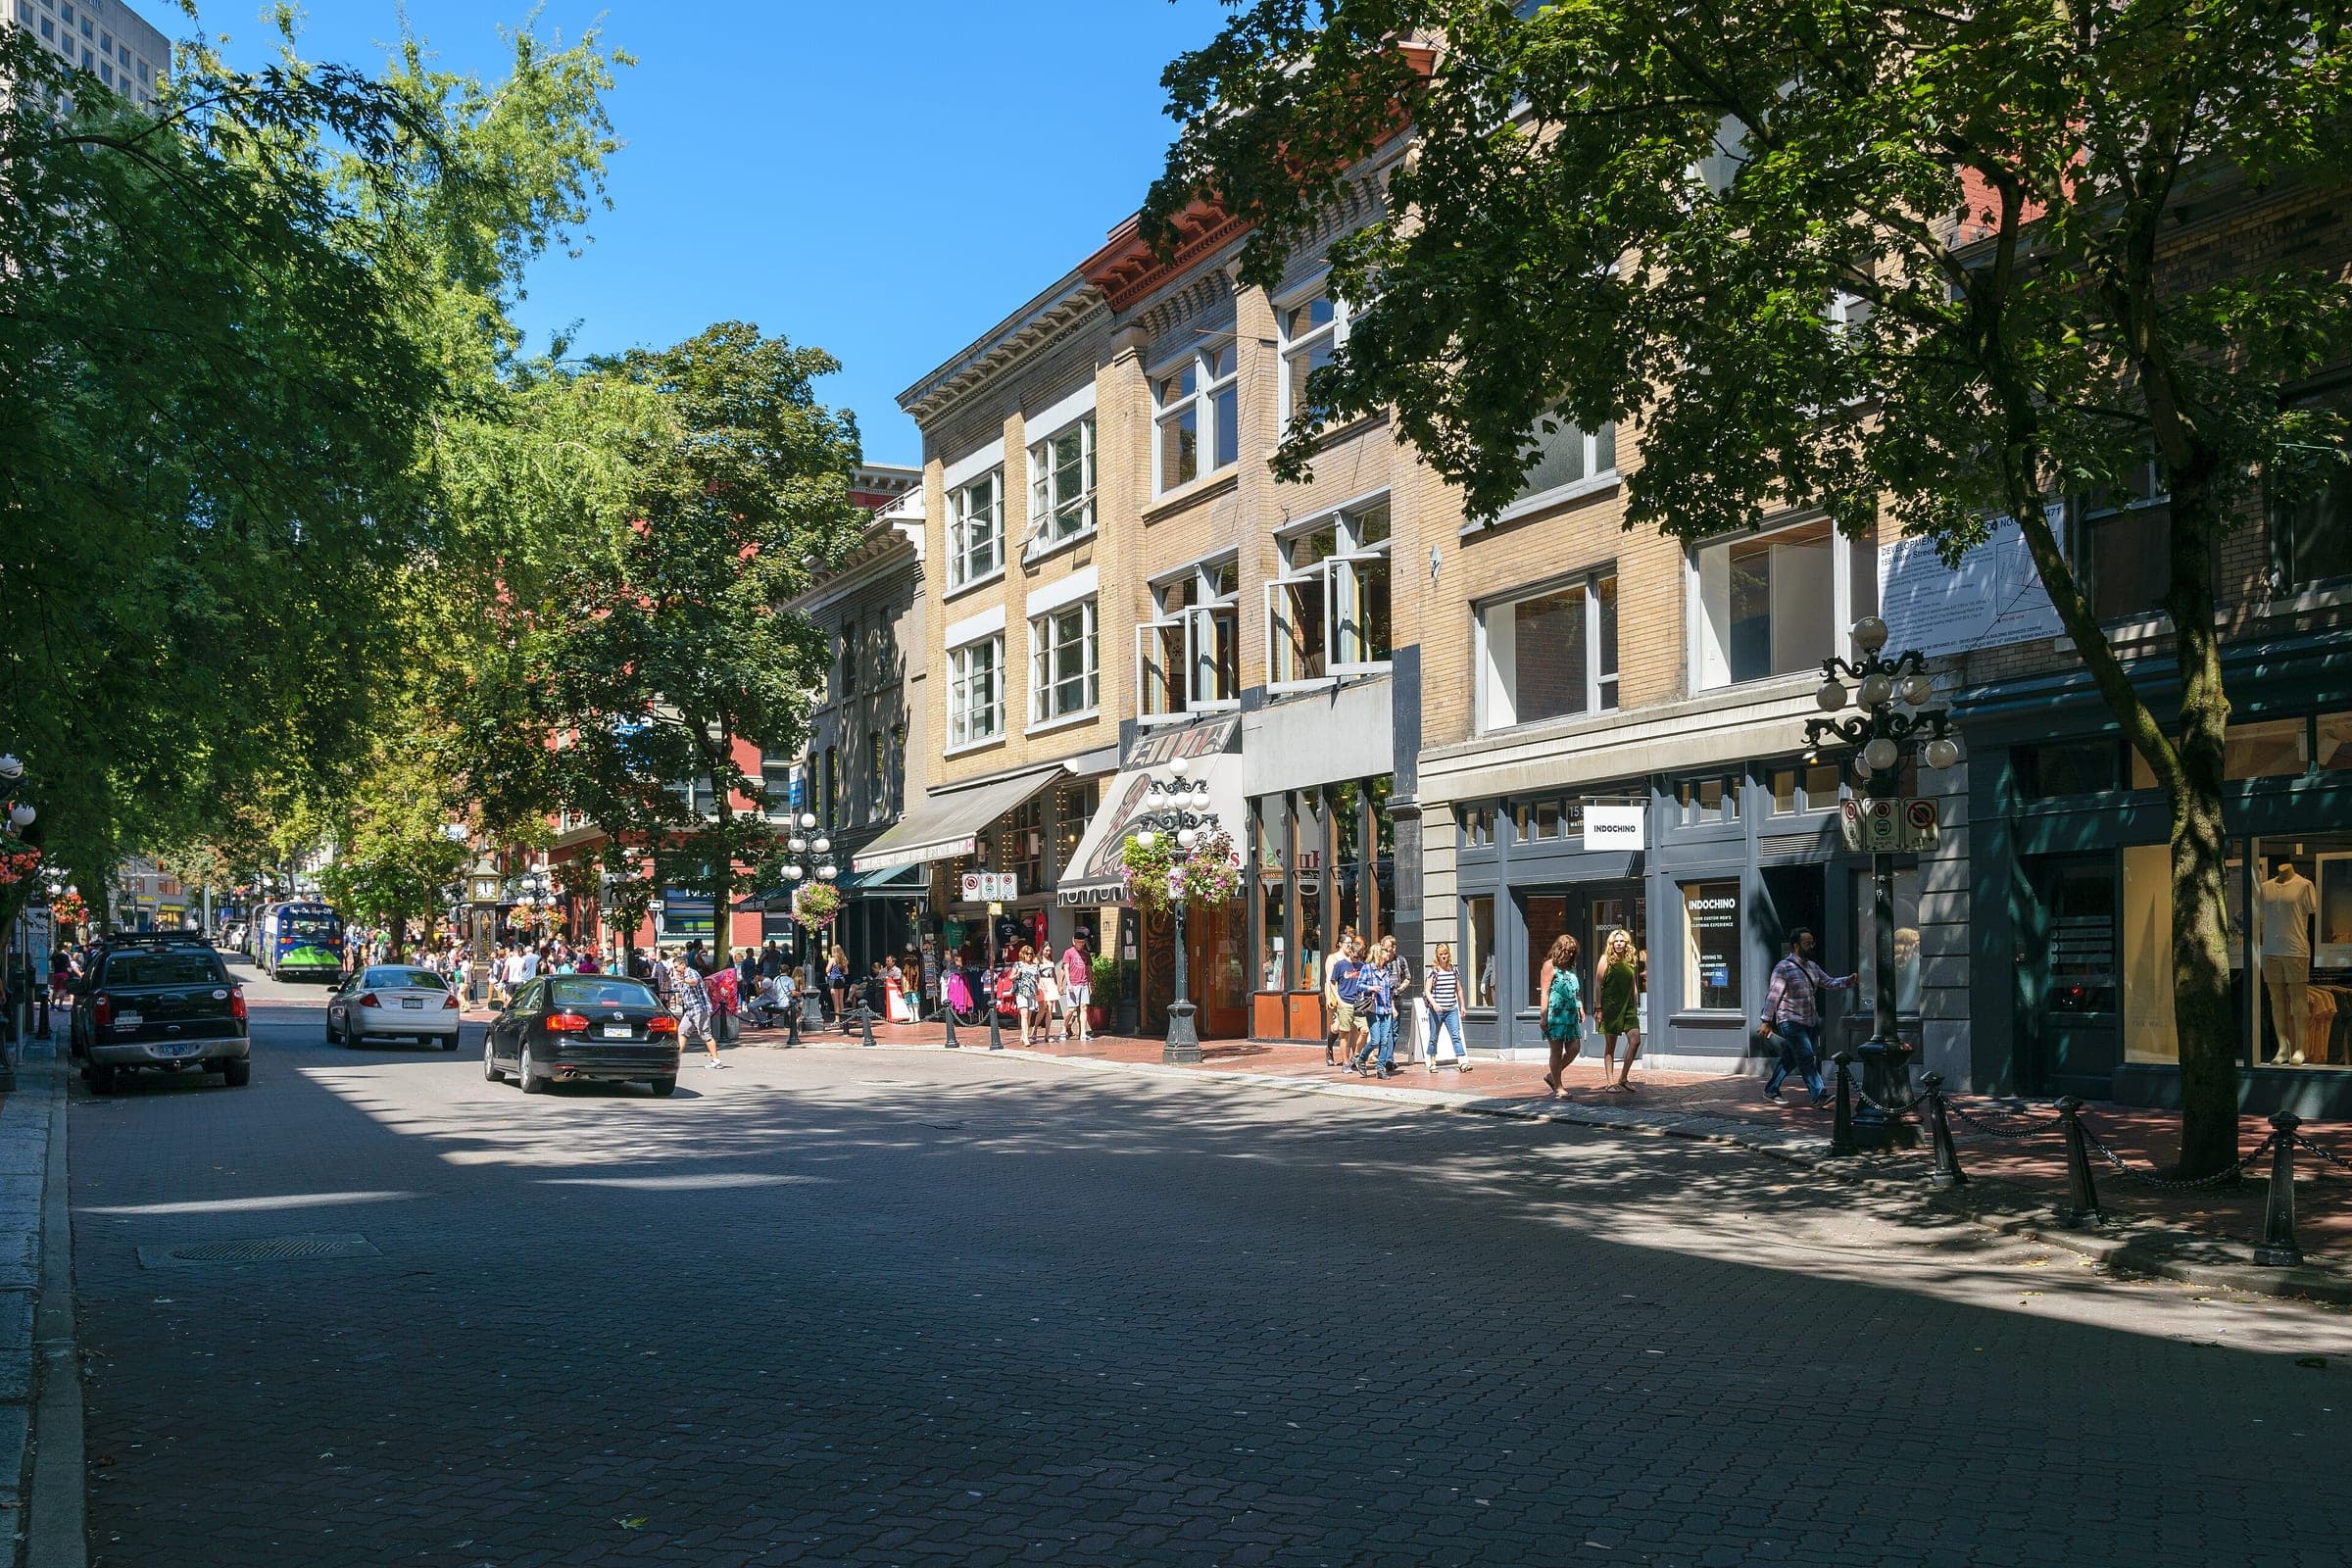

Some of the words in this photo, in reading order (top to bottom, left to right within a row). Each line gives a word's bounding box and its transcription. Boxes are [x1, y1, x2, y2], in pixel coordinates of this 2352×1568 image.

[1892, 554, 1911, 564] Water
[1913, 548, 1935, 559] Street
[1689, 898, 1736, 909] INDOCHINO
